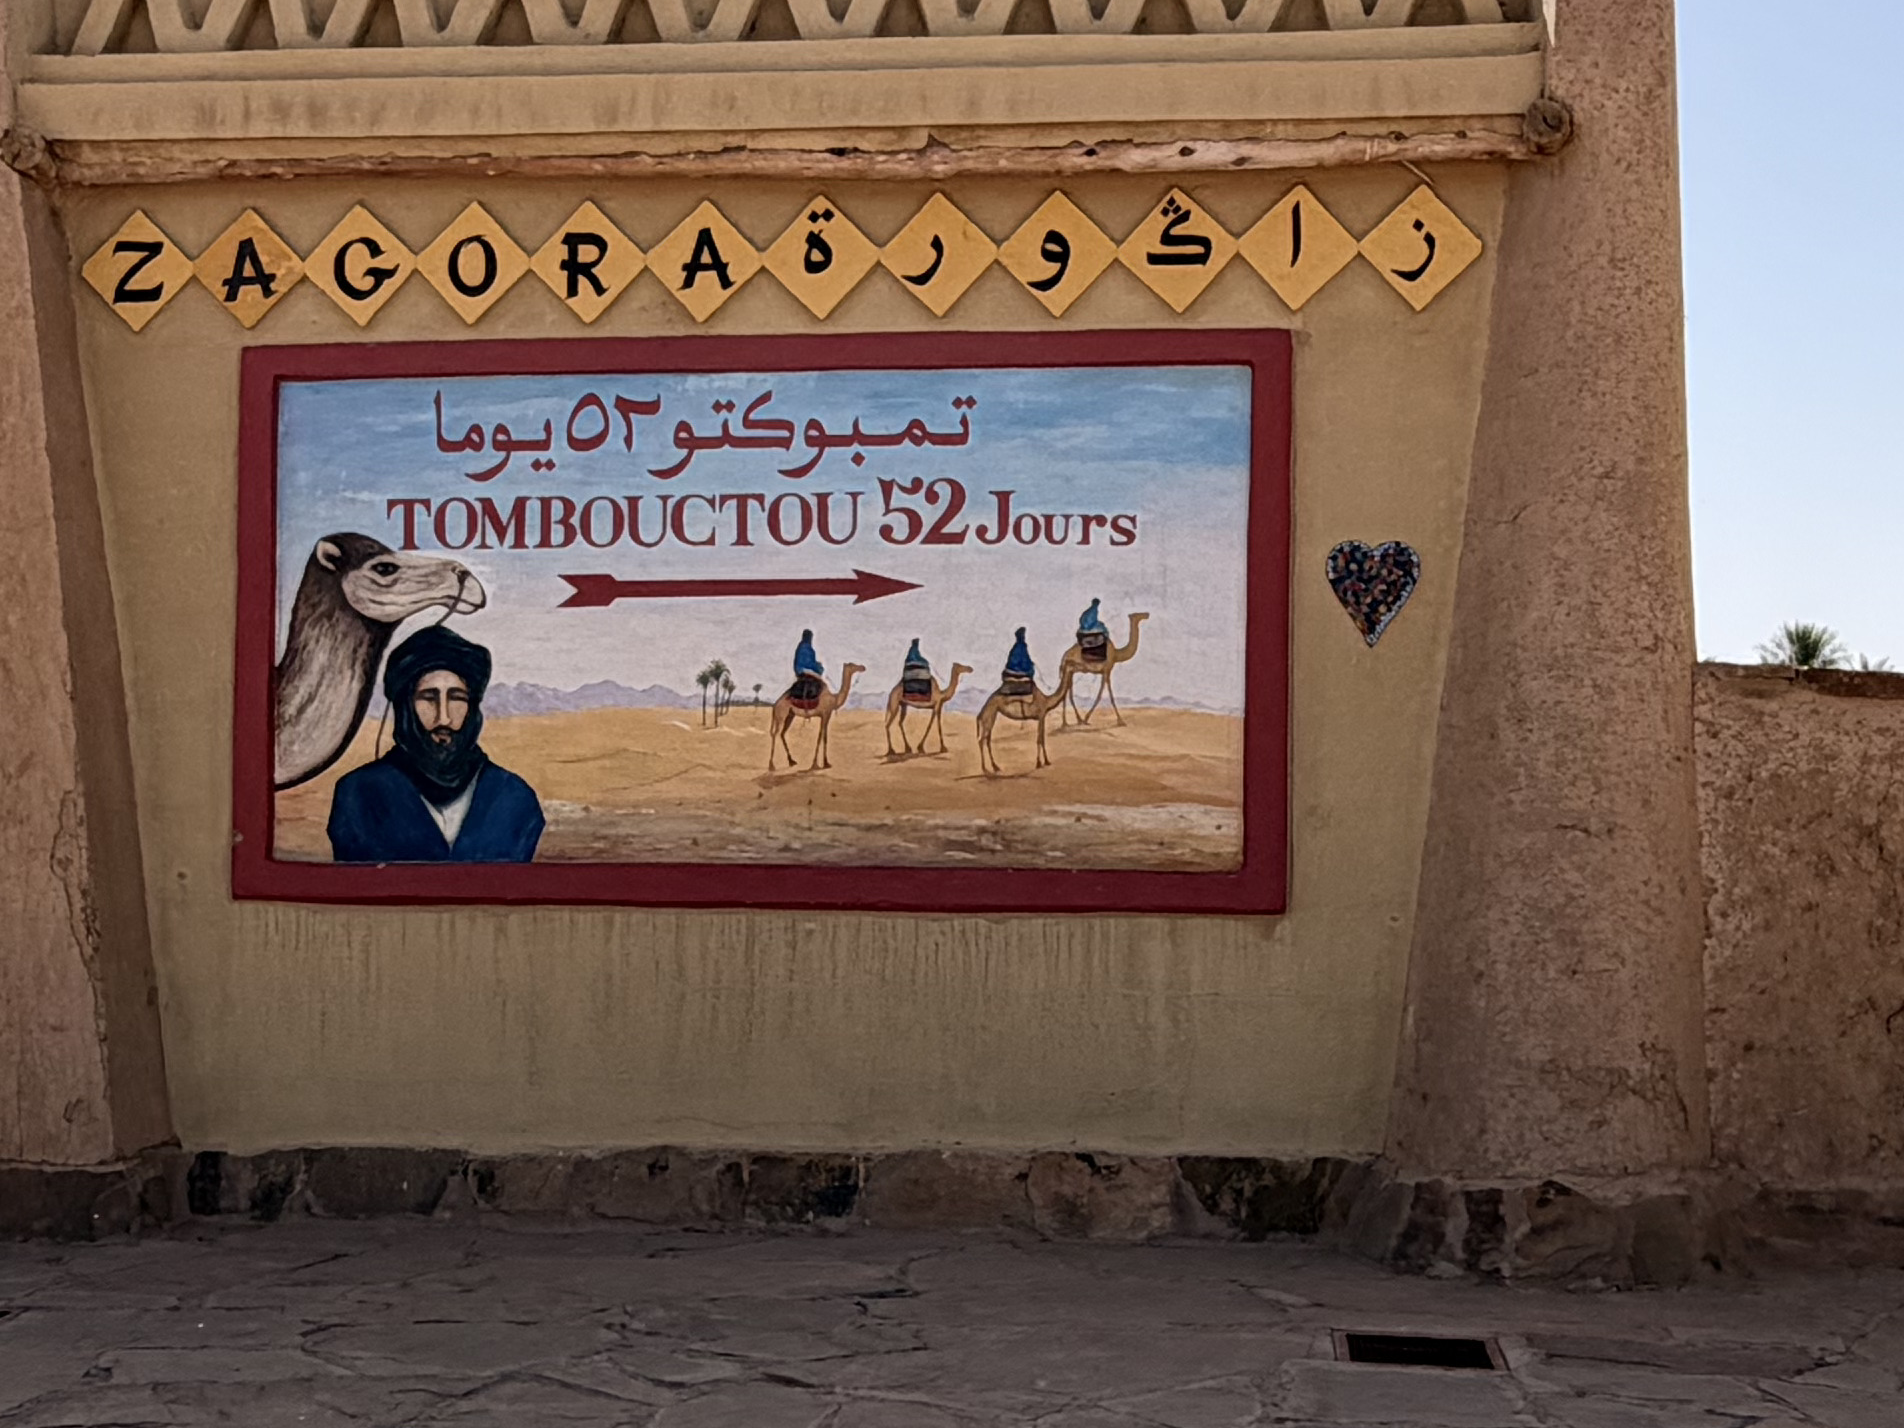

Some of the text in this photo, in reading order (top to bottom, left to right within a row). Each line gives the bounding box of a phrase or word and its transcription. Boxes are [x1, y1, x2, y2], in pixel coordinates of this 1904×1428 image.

[111, 226, 738, 305] ZAGORA
[432, 389, 978, 483] تمبوكتو ٥٢ يوما
[385, 476, 1138, 551] TOMBOUCTOU 52 Jours
